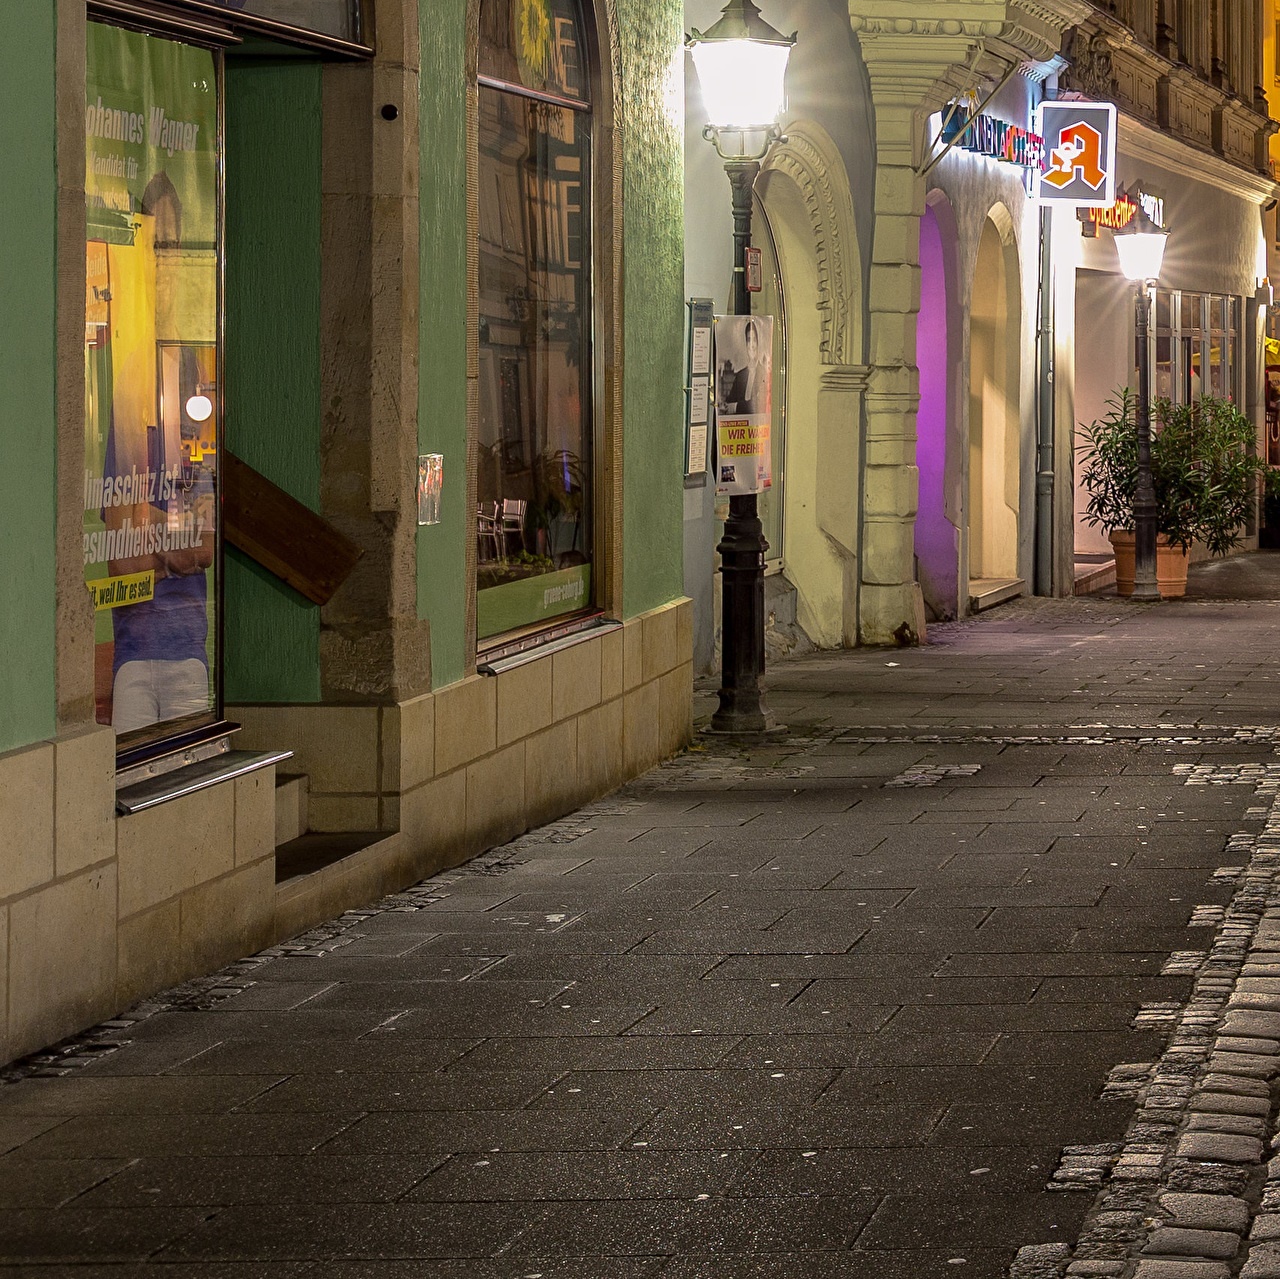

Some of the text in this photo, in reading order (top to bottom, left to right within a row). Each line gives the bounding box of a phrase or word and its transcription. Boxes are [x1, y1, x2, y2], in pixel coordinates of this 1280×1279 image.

[85, 96, 200, 158] ohannes Wagner
[721, 444, 734, 455] DIE
[728, 428, 745, 440] WIR
[84, 462, 181, 510] limaschutz ist
[83, 514, 205, 566] esundheitsschutz
[99, 583, 114, 606] weil
[116, 579, 128, 603] Ihr
[129, 585, 138, 599] es
